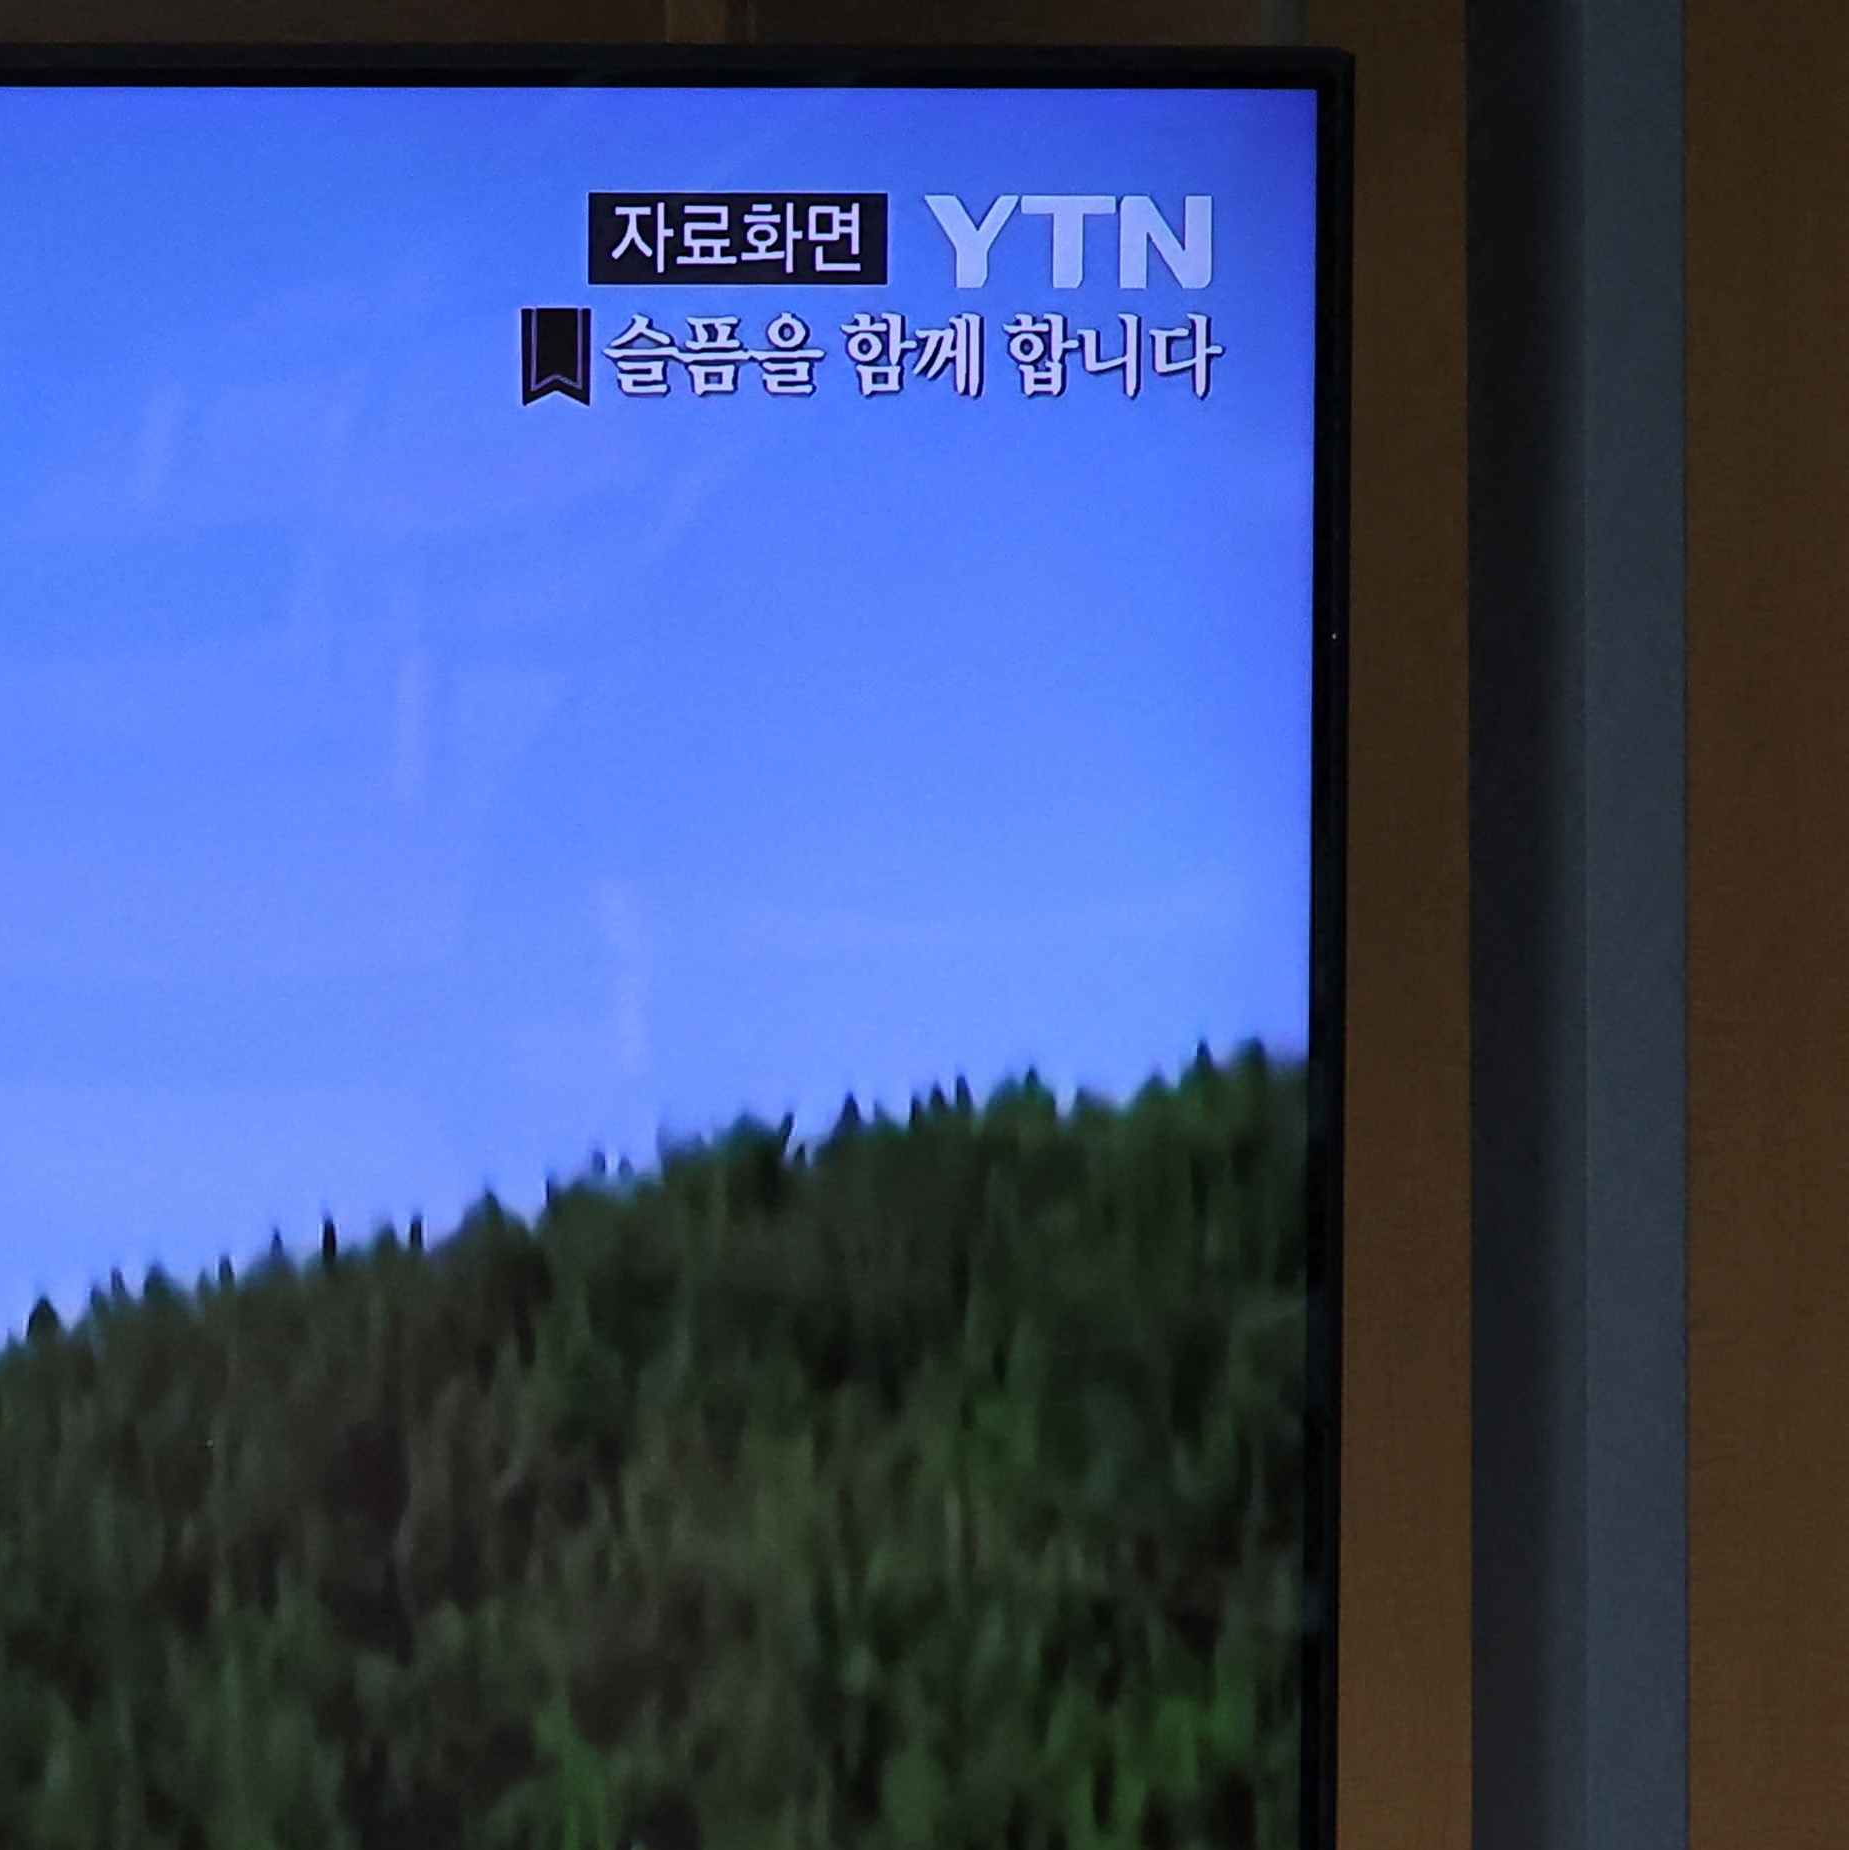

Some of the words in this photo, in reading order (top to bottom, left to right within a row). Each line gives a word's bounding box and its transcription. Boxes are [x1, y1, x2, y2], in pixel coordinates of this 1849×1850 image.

[610, 201, 862, 274] 자료화면
[923, 193, 1213, 290] YTN
[602, 311, 825, 397] 슬픔을
[839, 311, 981, 397] 함께
[1001, 312, 1223, 398] 합니다
